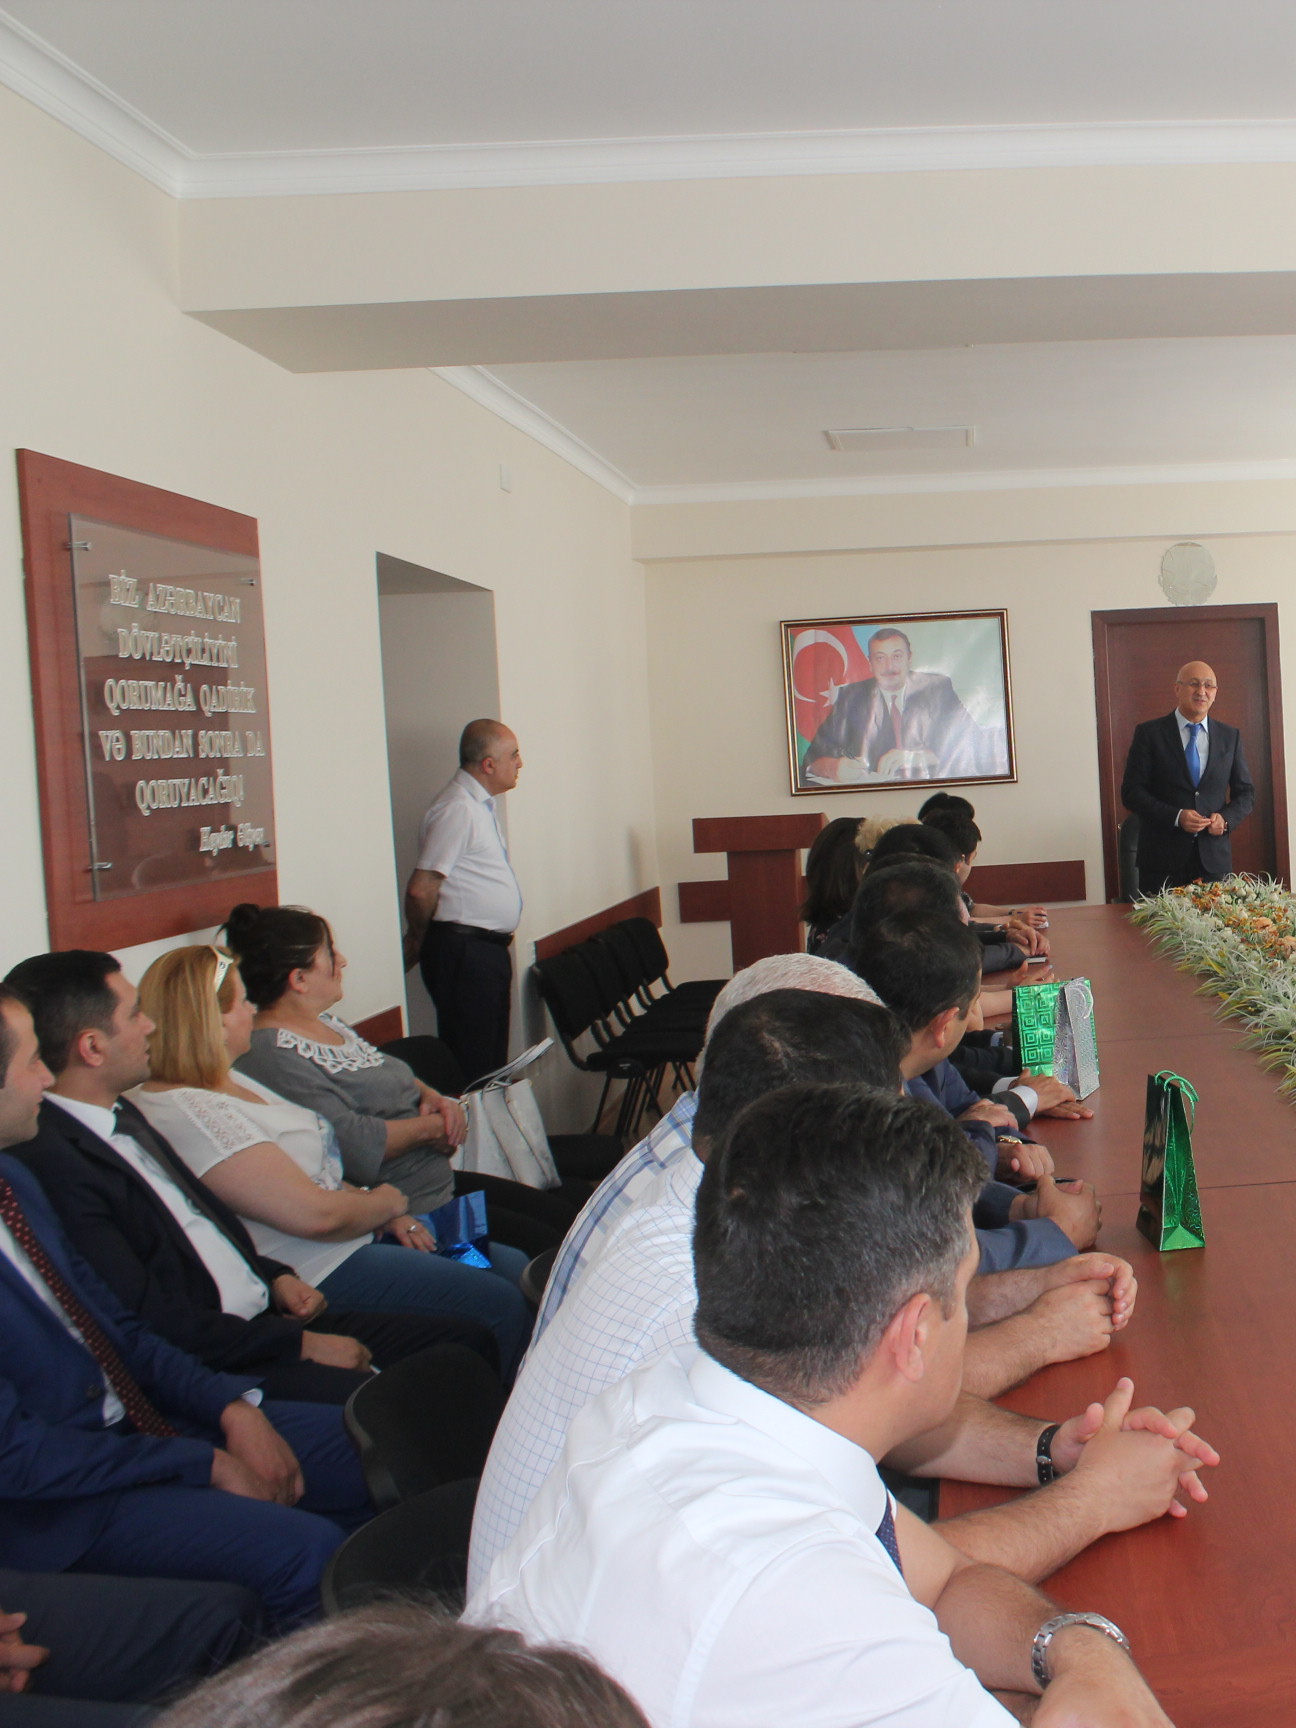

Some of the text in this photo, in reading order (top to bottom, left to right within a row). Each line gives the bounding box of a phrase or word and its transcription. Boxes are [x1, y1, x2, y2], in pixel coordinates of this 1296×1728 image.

[109, 570, 240, 623] BİZ AZƏRBAYCAN
[117, 623, 239, 670] DÖVLƏTÇİLİYİNİ
[104, 674, 196, 716] QORUMAĞA
[98, 729, 266, 761] VƏ BUNDAN SONRA DA
